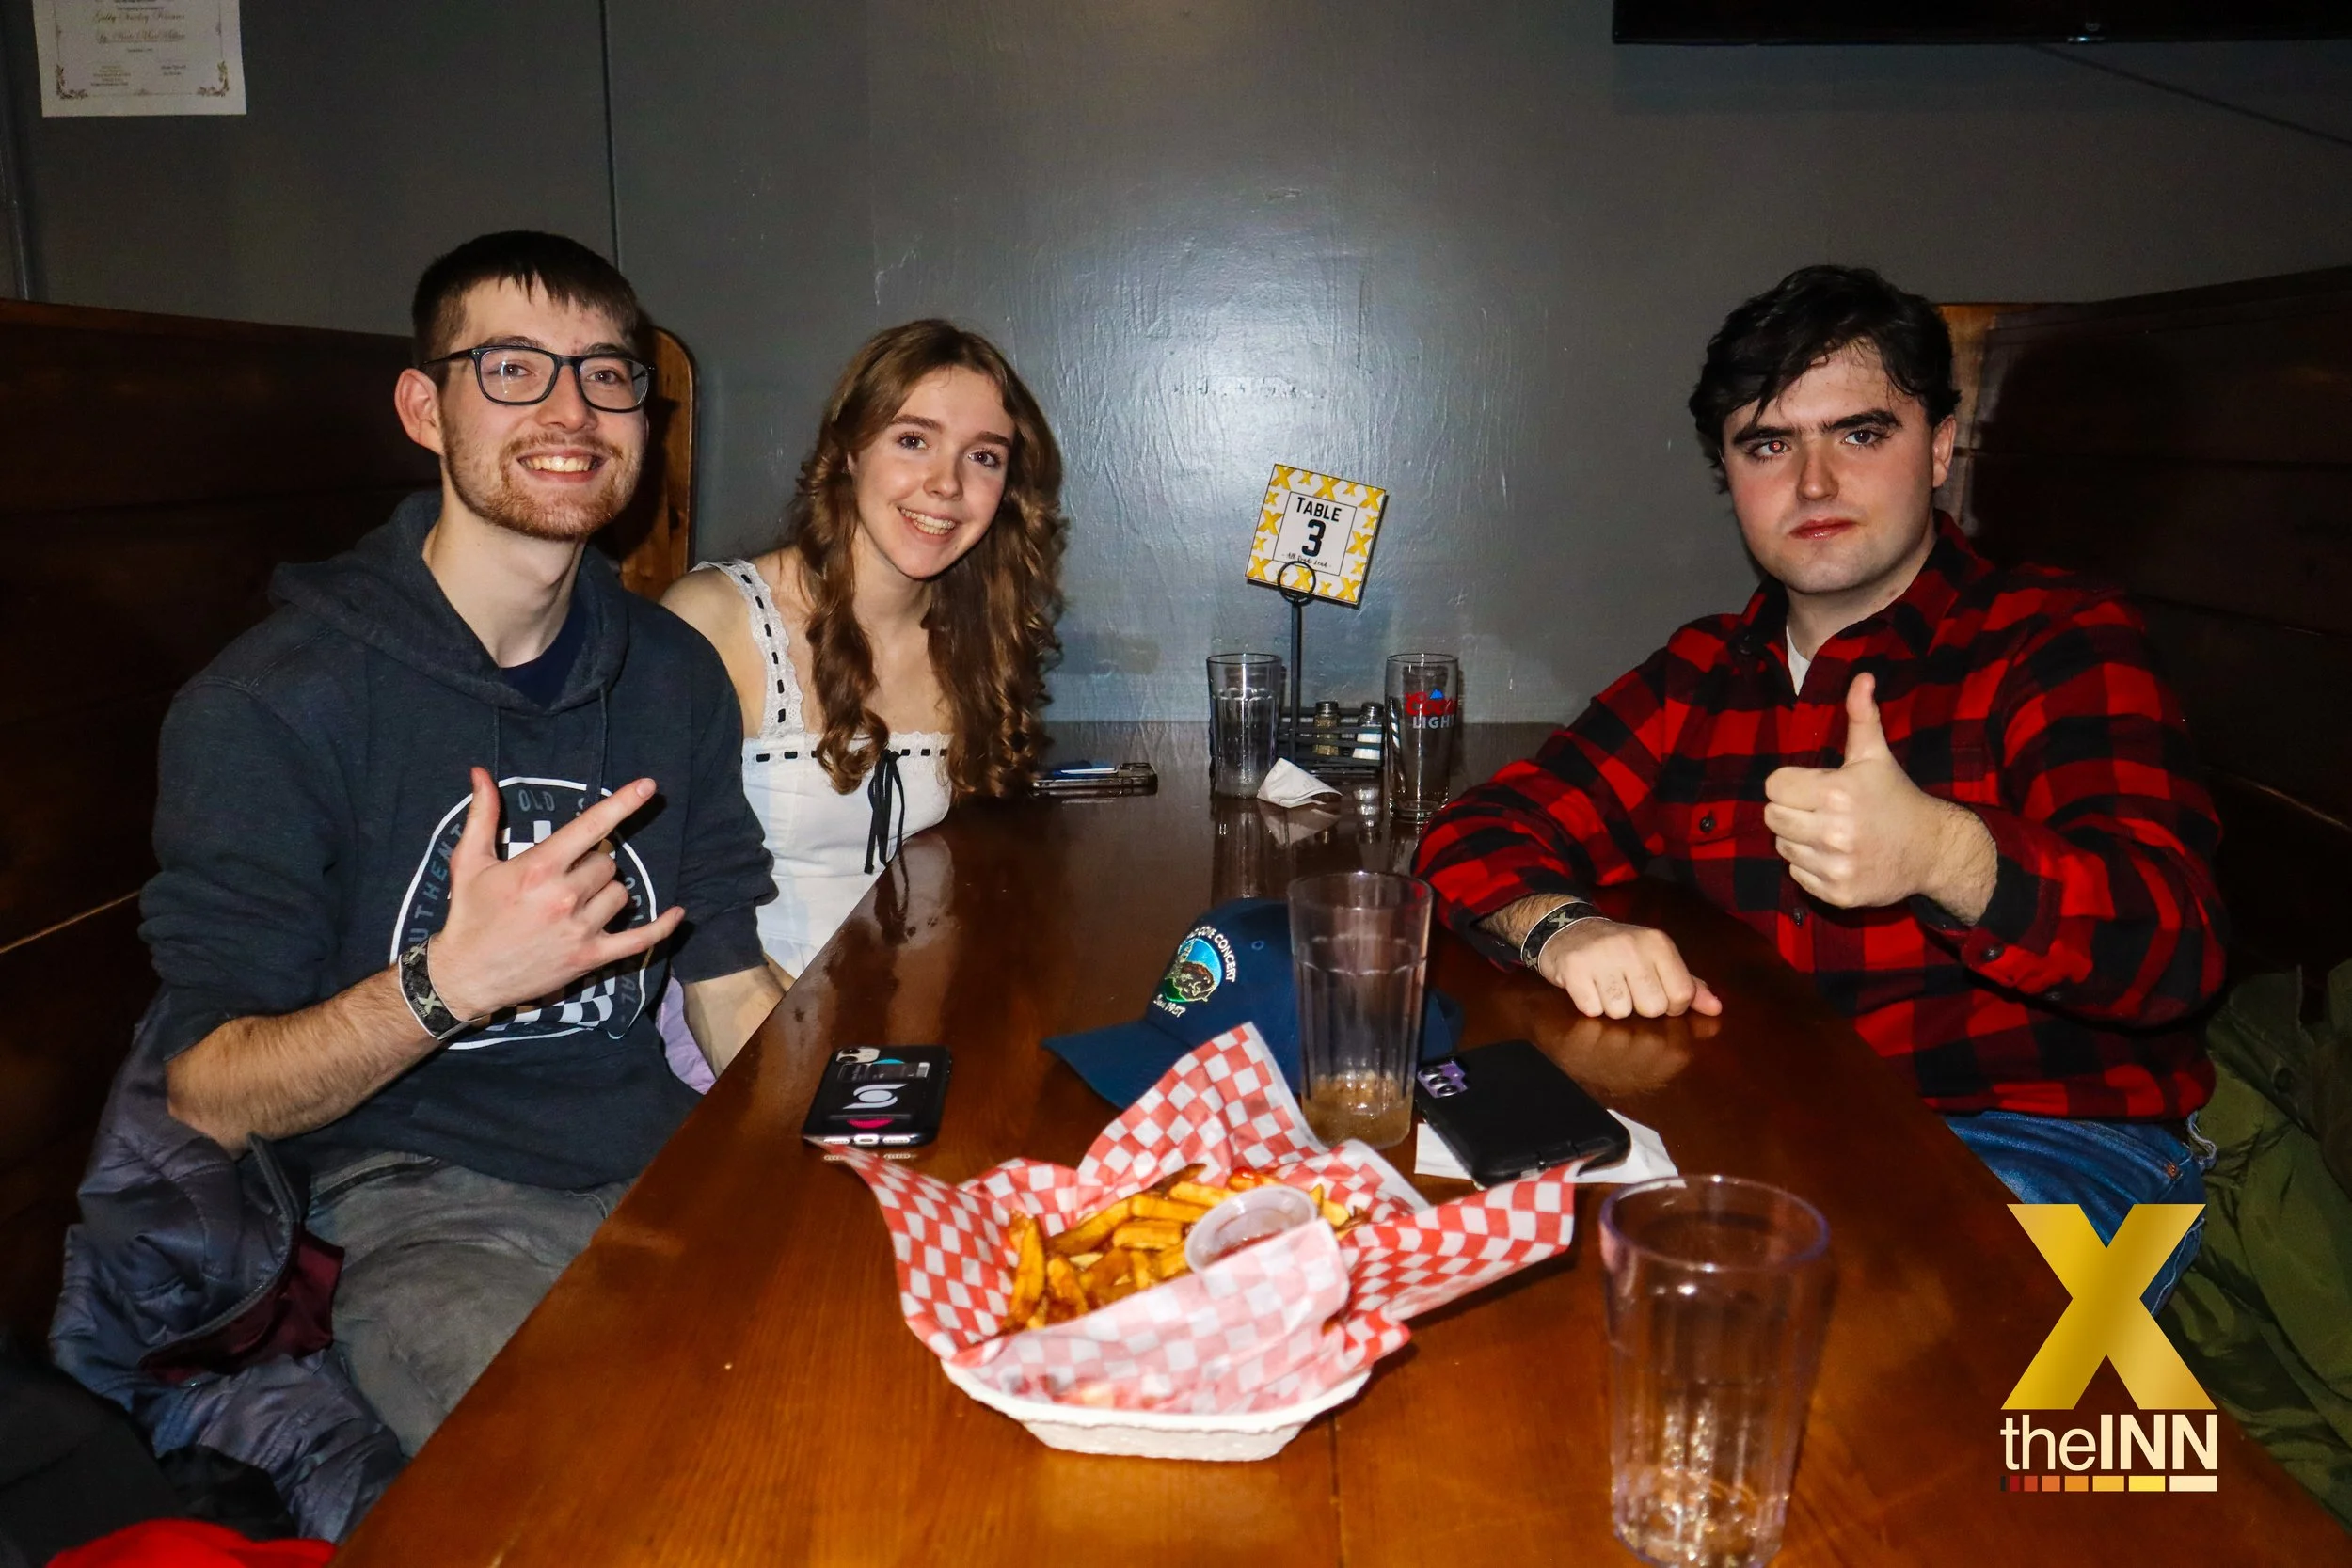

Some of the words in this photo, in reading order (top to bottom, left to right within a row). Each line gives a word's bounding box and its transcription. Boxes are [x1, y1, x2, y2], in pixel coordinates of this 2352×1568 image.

[1295, 496, 1343, 522] TABLE
[1301, 518, 1327, 558] 3
[517, 788, 556, 813] OLD
[408, 821, 465, 942] UTHENT
[1214, 933, 1236, 983] CONCERT
[1163, 1002, 1187, 1018] 1957
